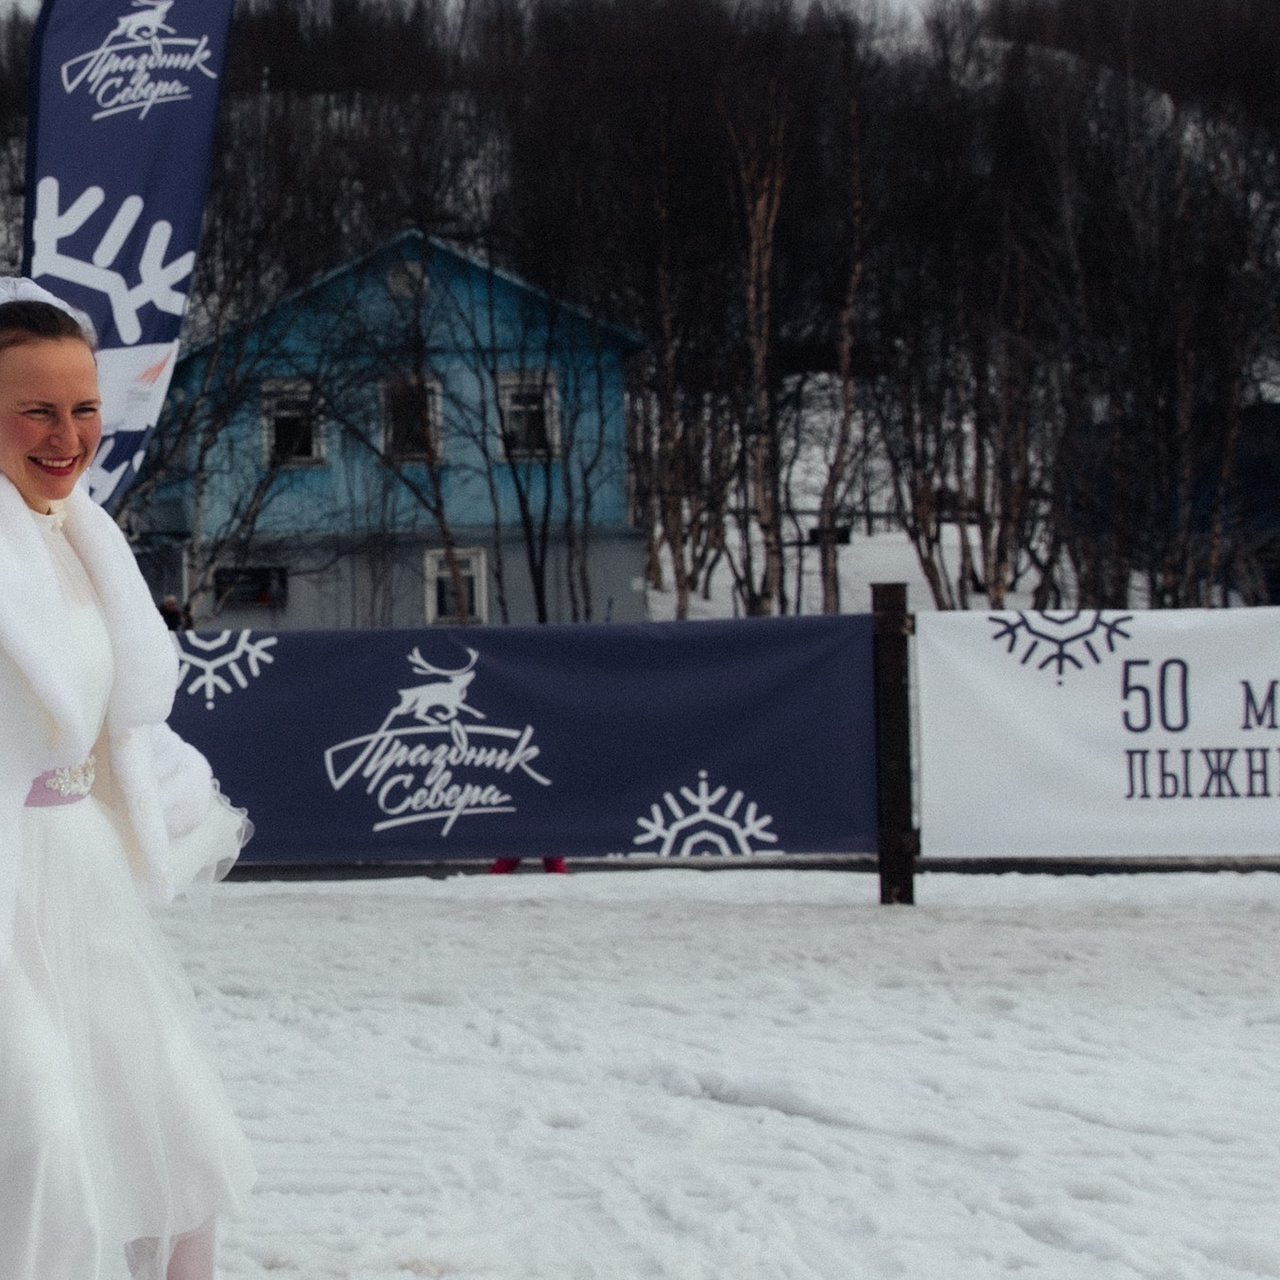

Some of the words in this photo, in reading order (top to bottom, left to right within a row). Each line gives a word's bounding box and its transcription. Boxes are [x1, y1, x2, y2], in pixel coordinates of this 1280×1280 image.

[61, 35, 218, 95] Праздник
[96, 73, 190, 120] Севера
[1121, 658, 1189, 733] 50
[324, 719, 553, 795] Праздник
[1125, 747, 1280, 799] ЛЫЖН
[377, 770, 514, 837] Севера
